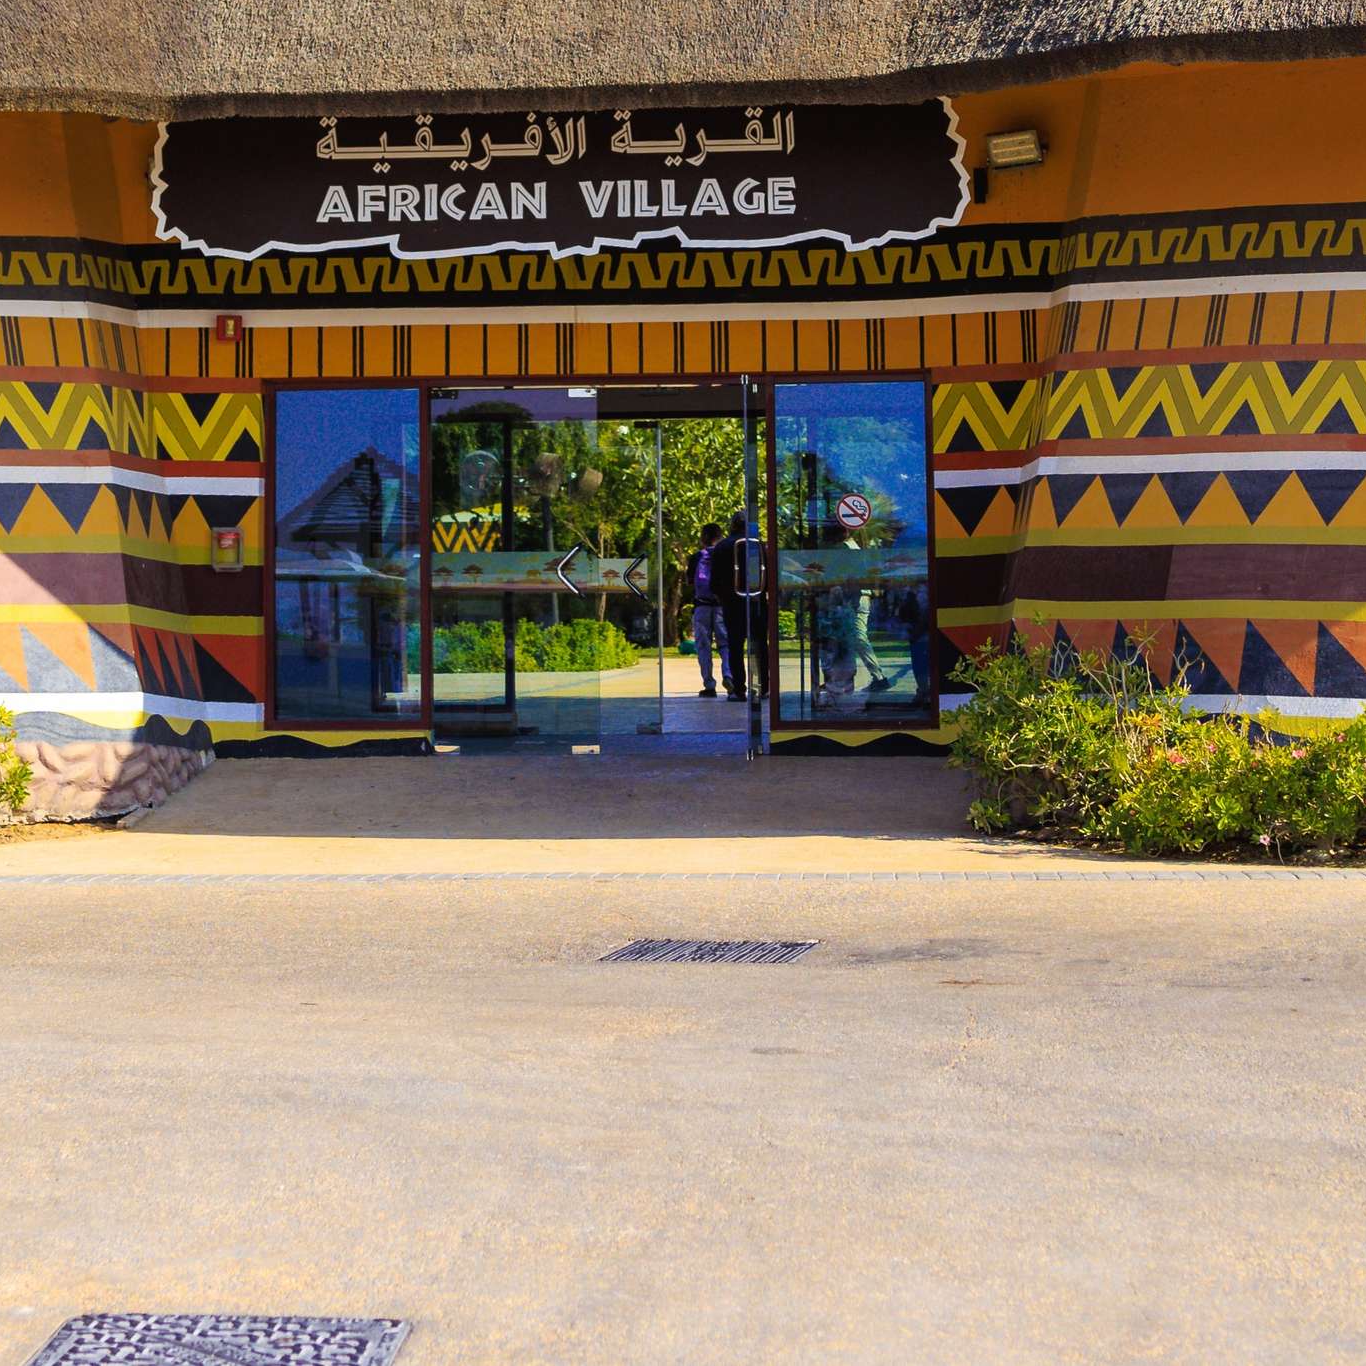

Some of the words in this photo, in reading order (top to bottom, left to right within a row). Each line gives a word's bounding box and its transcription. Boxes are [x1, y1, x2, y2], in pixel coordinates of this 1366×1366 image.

[316, 112, 587, 173] الأفريقية
[611, 107, 795, 166] القرية
[316, 181, 547, 222] AFRICAN
[579, 177, 796, 218] VILLAGE
